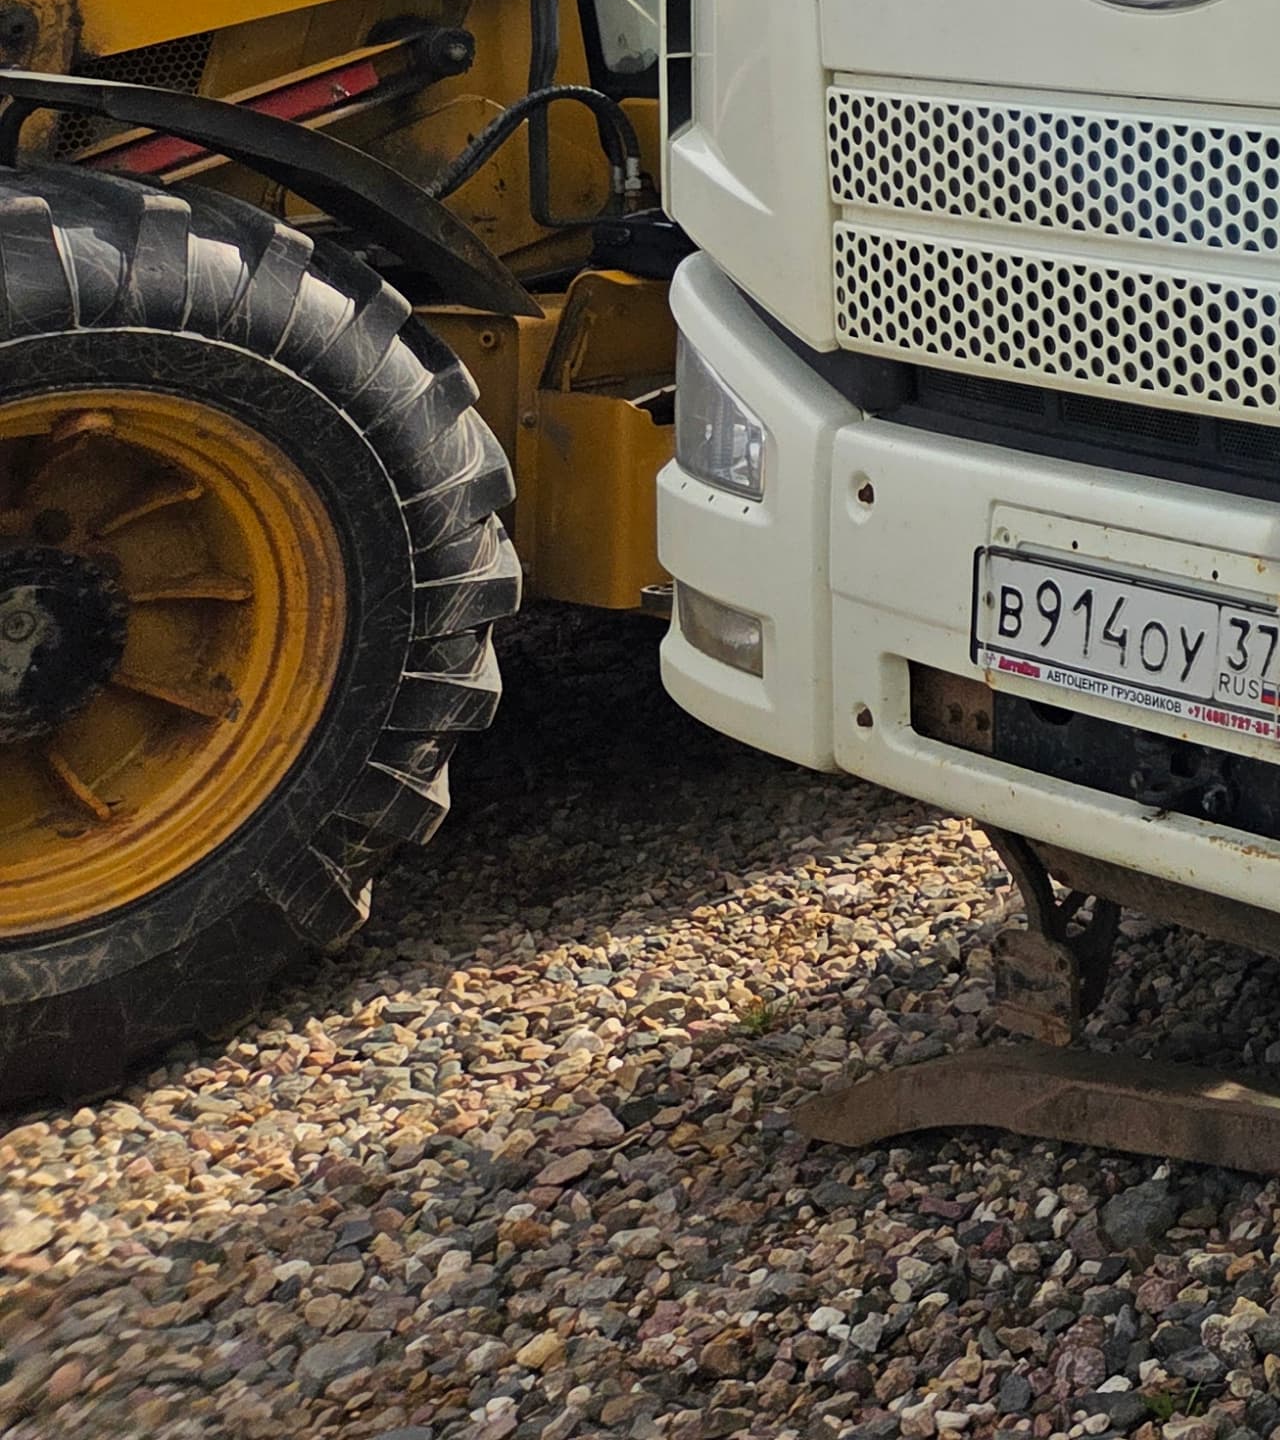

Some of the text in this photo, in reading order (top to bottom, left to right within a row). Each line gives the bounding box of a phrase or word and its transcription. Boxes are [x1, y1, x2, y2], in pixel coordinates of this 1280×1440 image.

[1226, 617, 1278, 677] 37
[1046, 670, 1109, 694] АВТОЦЕНТР
[1111, 686, 1182, 714] ГРУЗОВИКОВ
[1218, 672, 1260, 700] RUS
